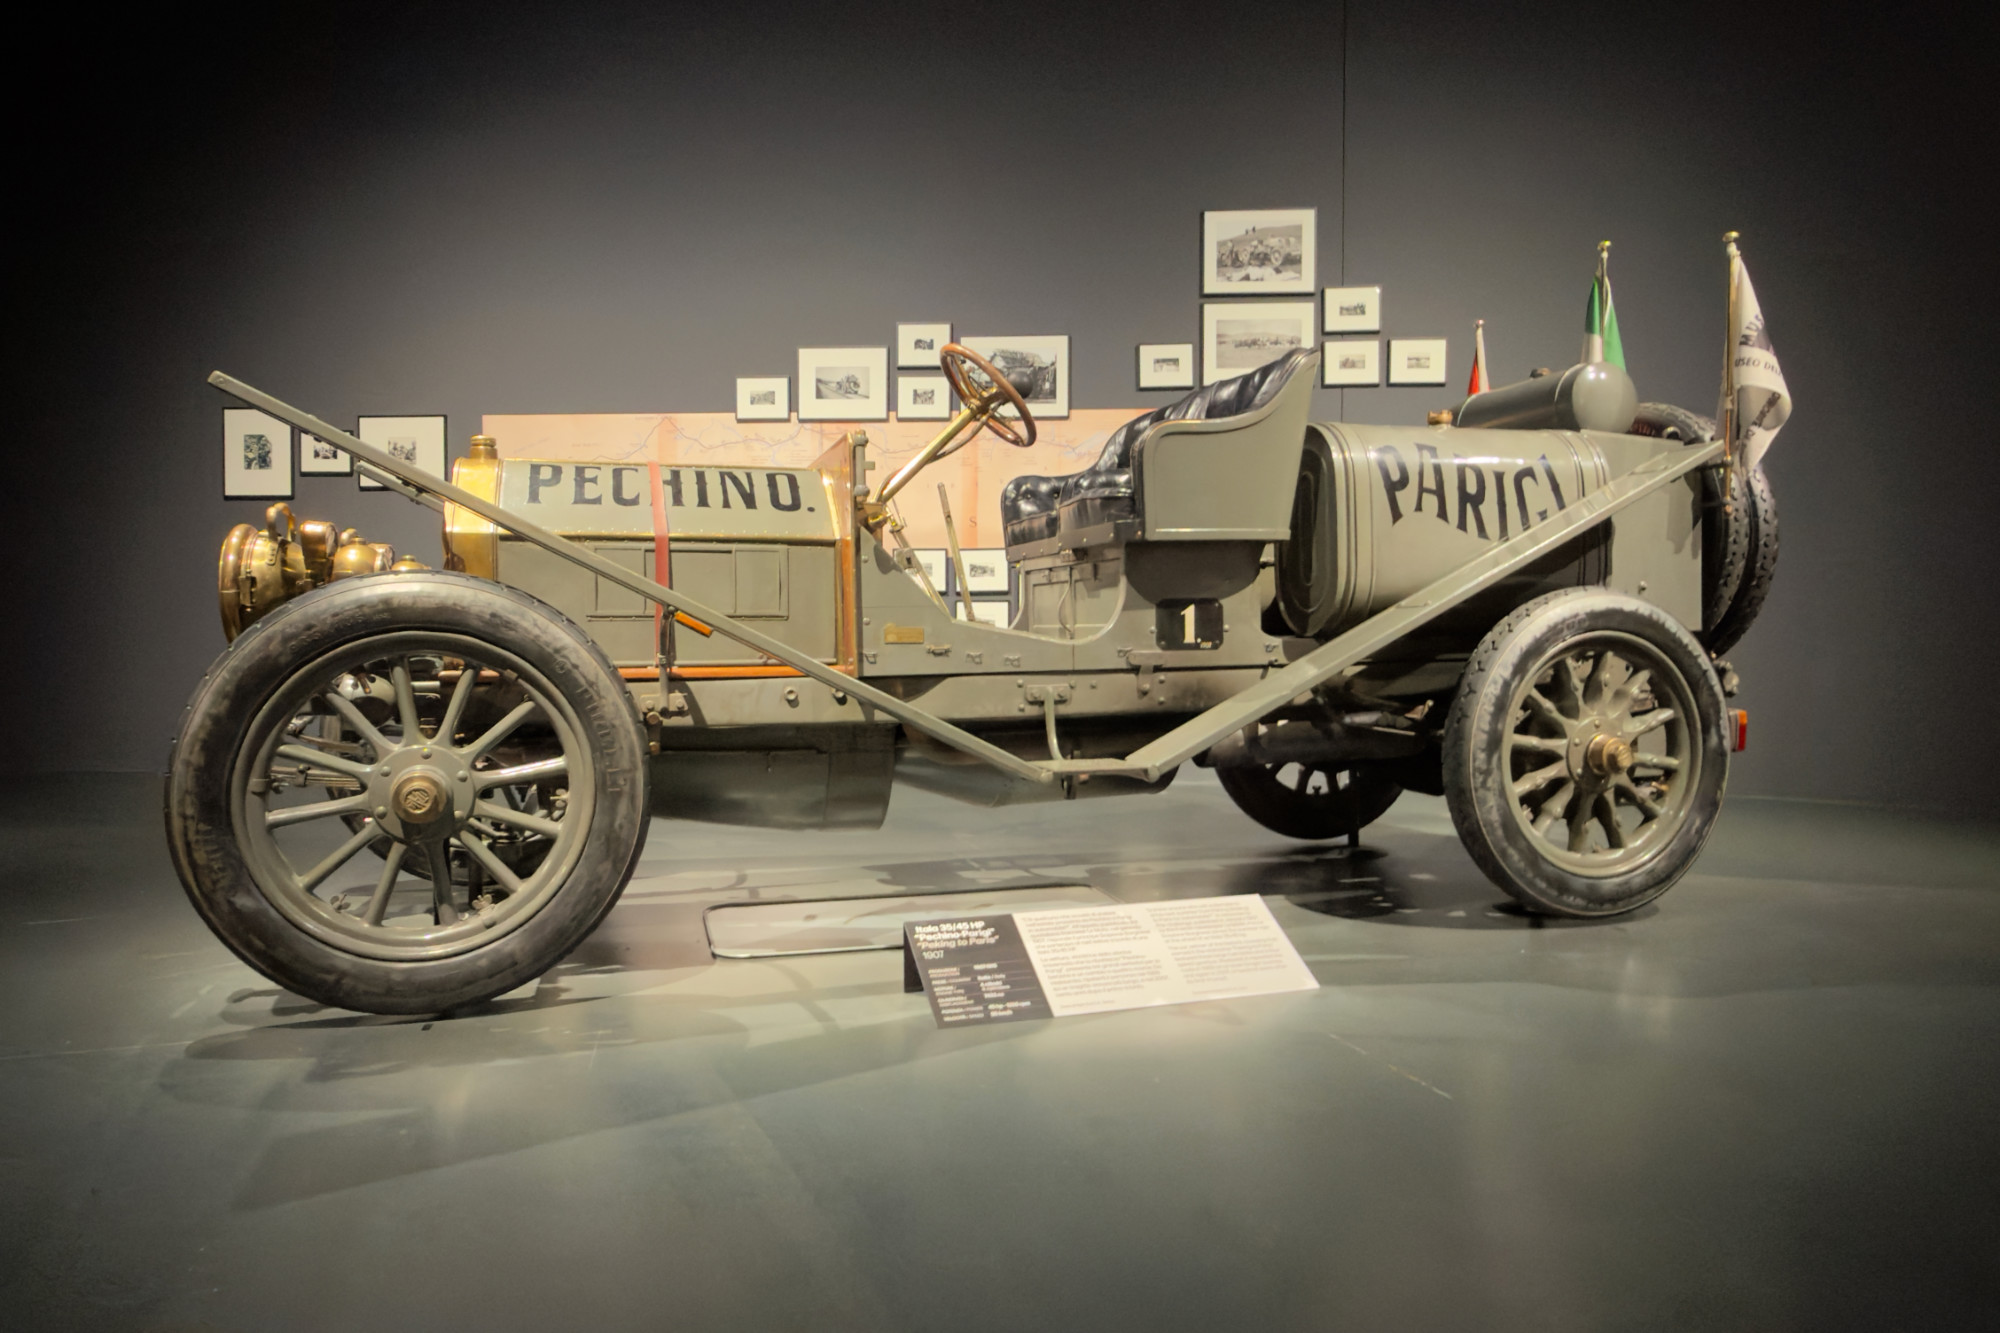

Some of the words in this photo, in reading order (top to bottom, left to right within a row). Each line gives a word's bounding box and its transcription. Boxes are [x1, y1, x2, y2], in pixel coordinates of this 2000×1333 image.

[1734, 356, 1761, 368] USEO
[1375, 442, 1567, 542] PARIGI
[922, 949, 944, 960] 1907
